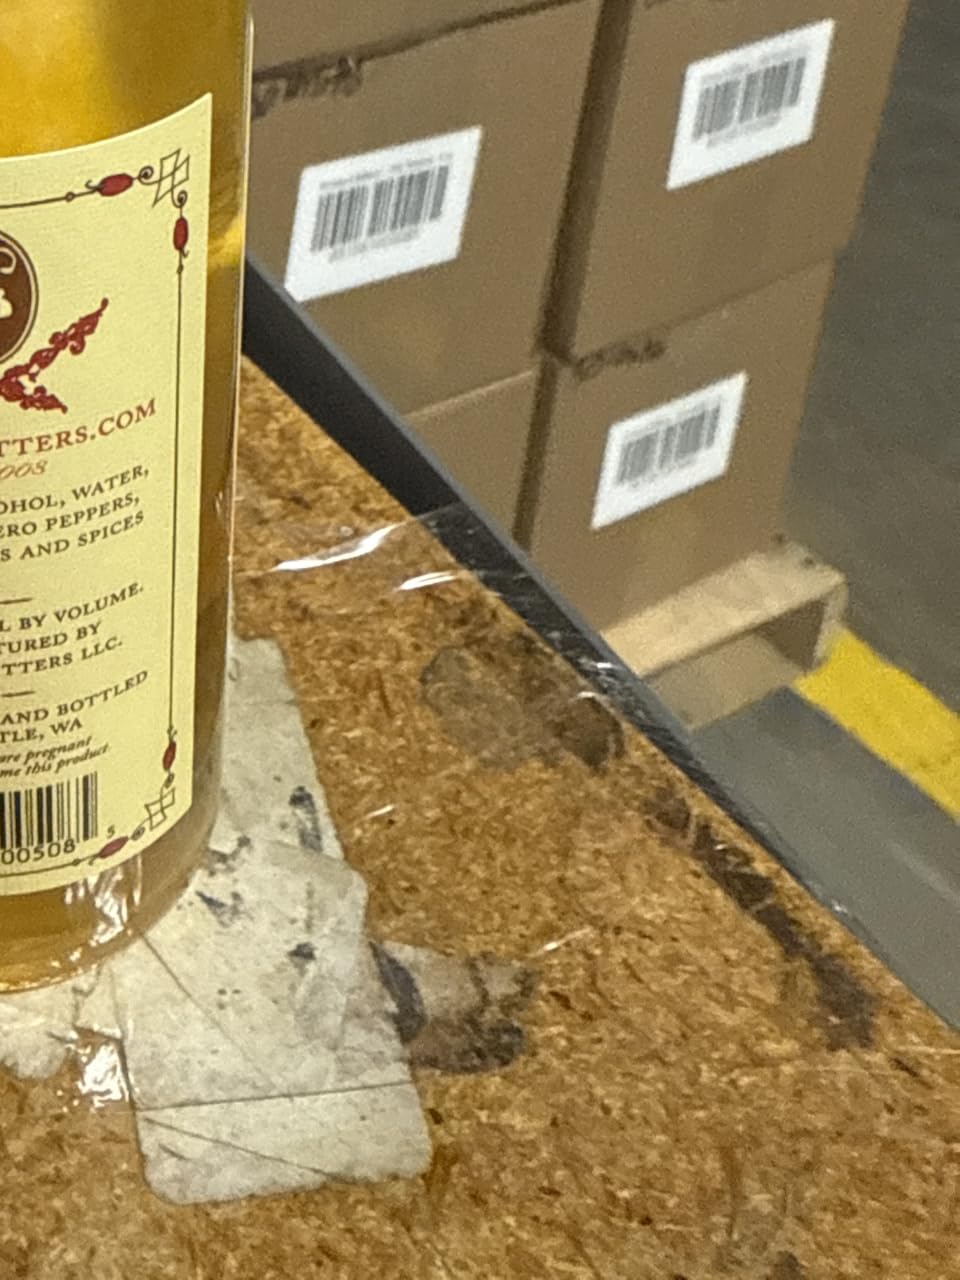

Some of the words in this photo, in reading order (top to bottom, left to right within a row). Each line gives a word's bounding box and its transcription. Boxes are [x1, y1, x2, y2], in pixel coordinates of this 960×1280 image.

[71, 465, 150, 502] WATER,
[45, 493, 141, 533] PEPPERS,
[20, 538, 71, 561] AND
[77, 510, 145, 548] SPICES
[19, 614, 48, 631] BY
[54, 582, 145, 624] VOLUME.
[75, 621, 103, 640] BY
[81, 637, 124, 661] LLC.
[0, 708, 50, 725] AND
[56, 670, 149, 716] BOTTLED
[50, 716, 84, 736] WA
[24, 735, 93, 763] pregnant
[24, 760, 52, 776] this
[0, 838, 77, 866] 00508
